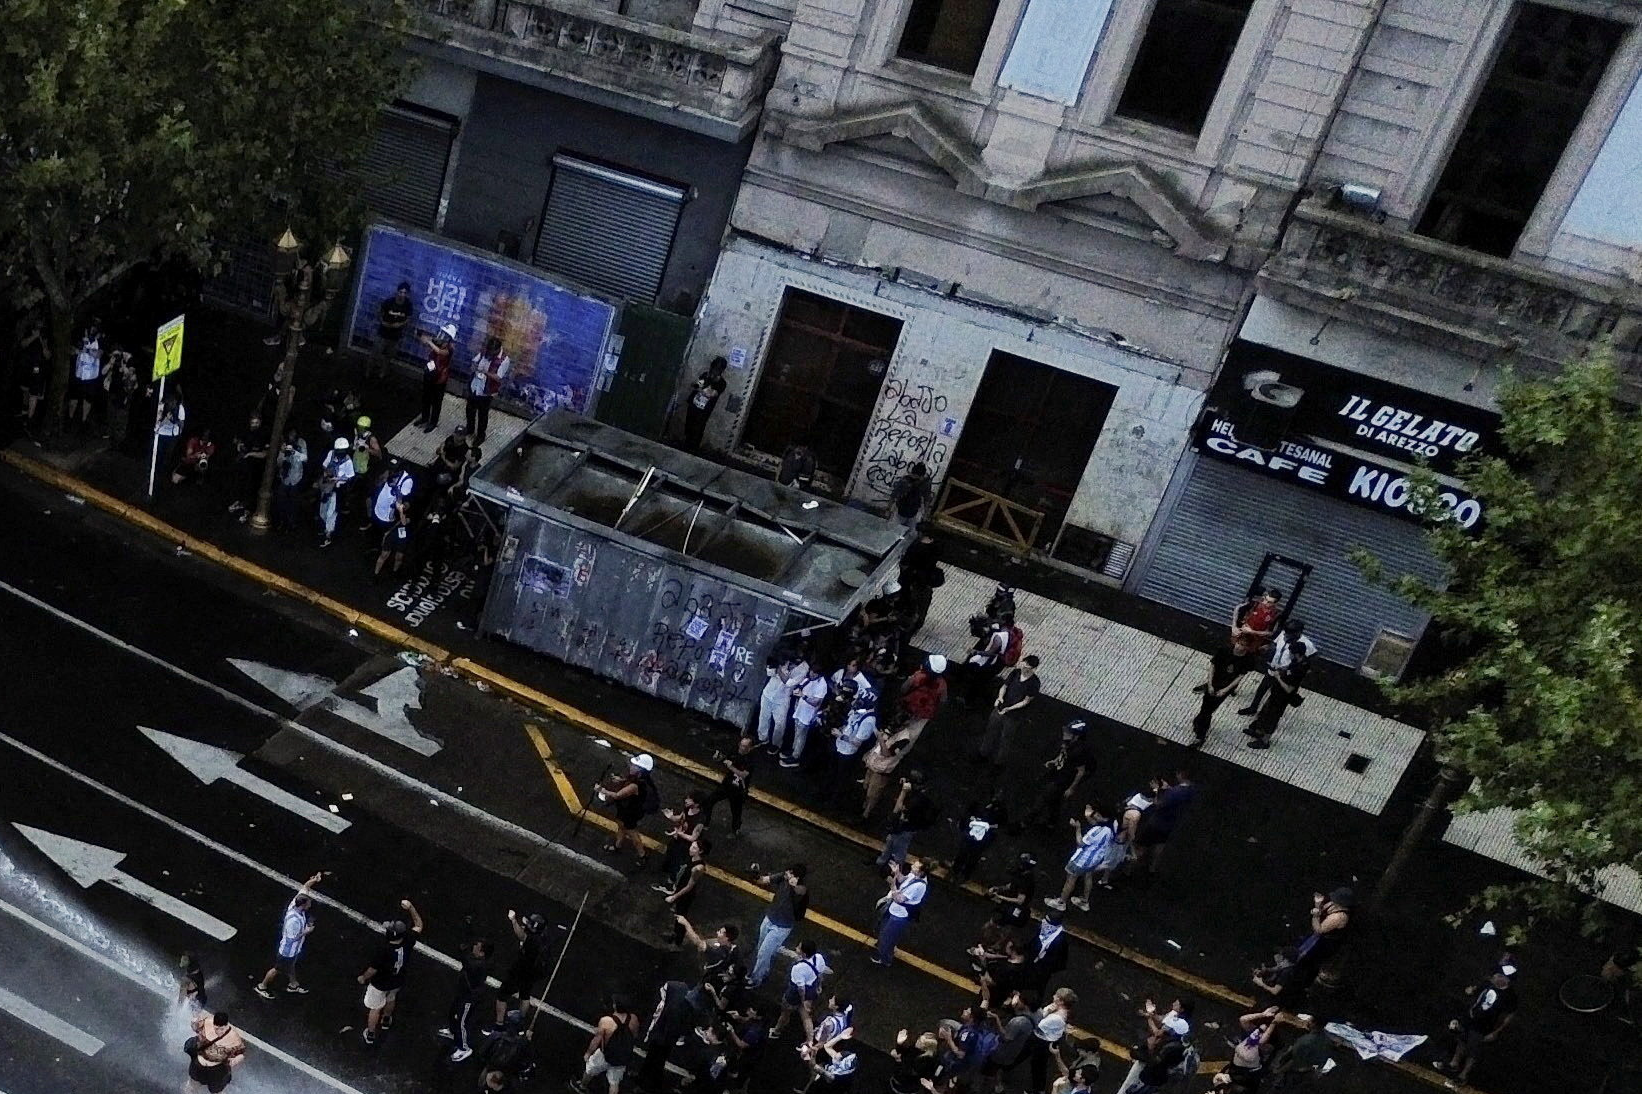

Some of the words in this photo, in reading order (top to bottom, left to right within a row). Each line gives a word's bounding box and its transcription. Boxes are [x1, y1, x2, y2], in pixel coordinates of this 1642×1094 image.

[1338, 395, 1372, 420] IL
[1370, 404, 1480, 452] GELATO
[1356, 424, 1373, 437] DI
[1378, 430, 1439, 457] AREZZO
[1207, 437, 1329, 485] CAFE
